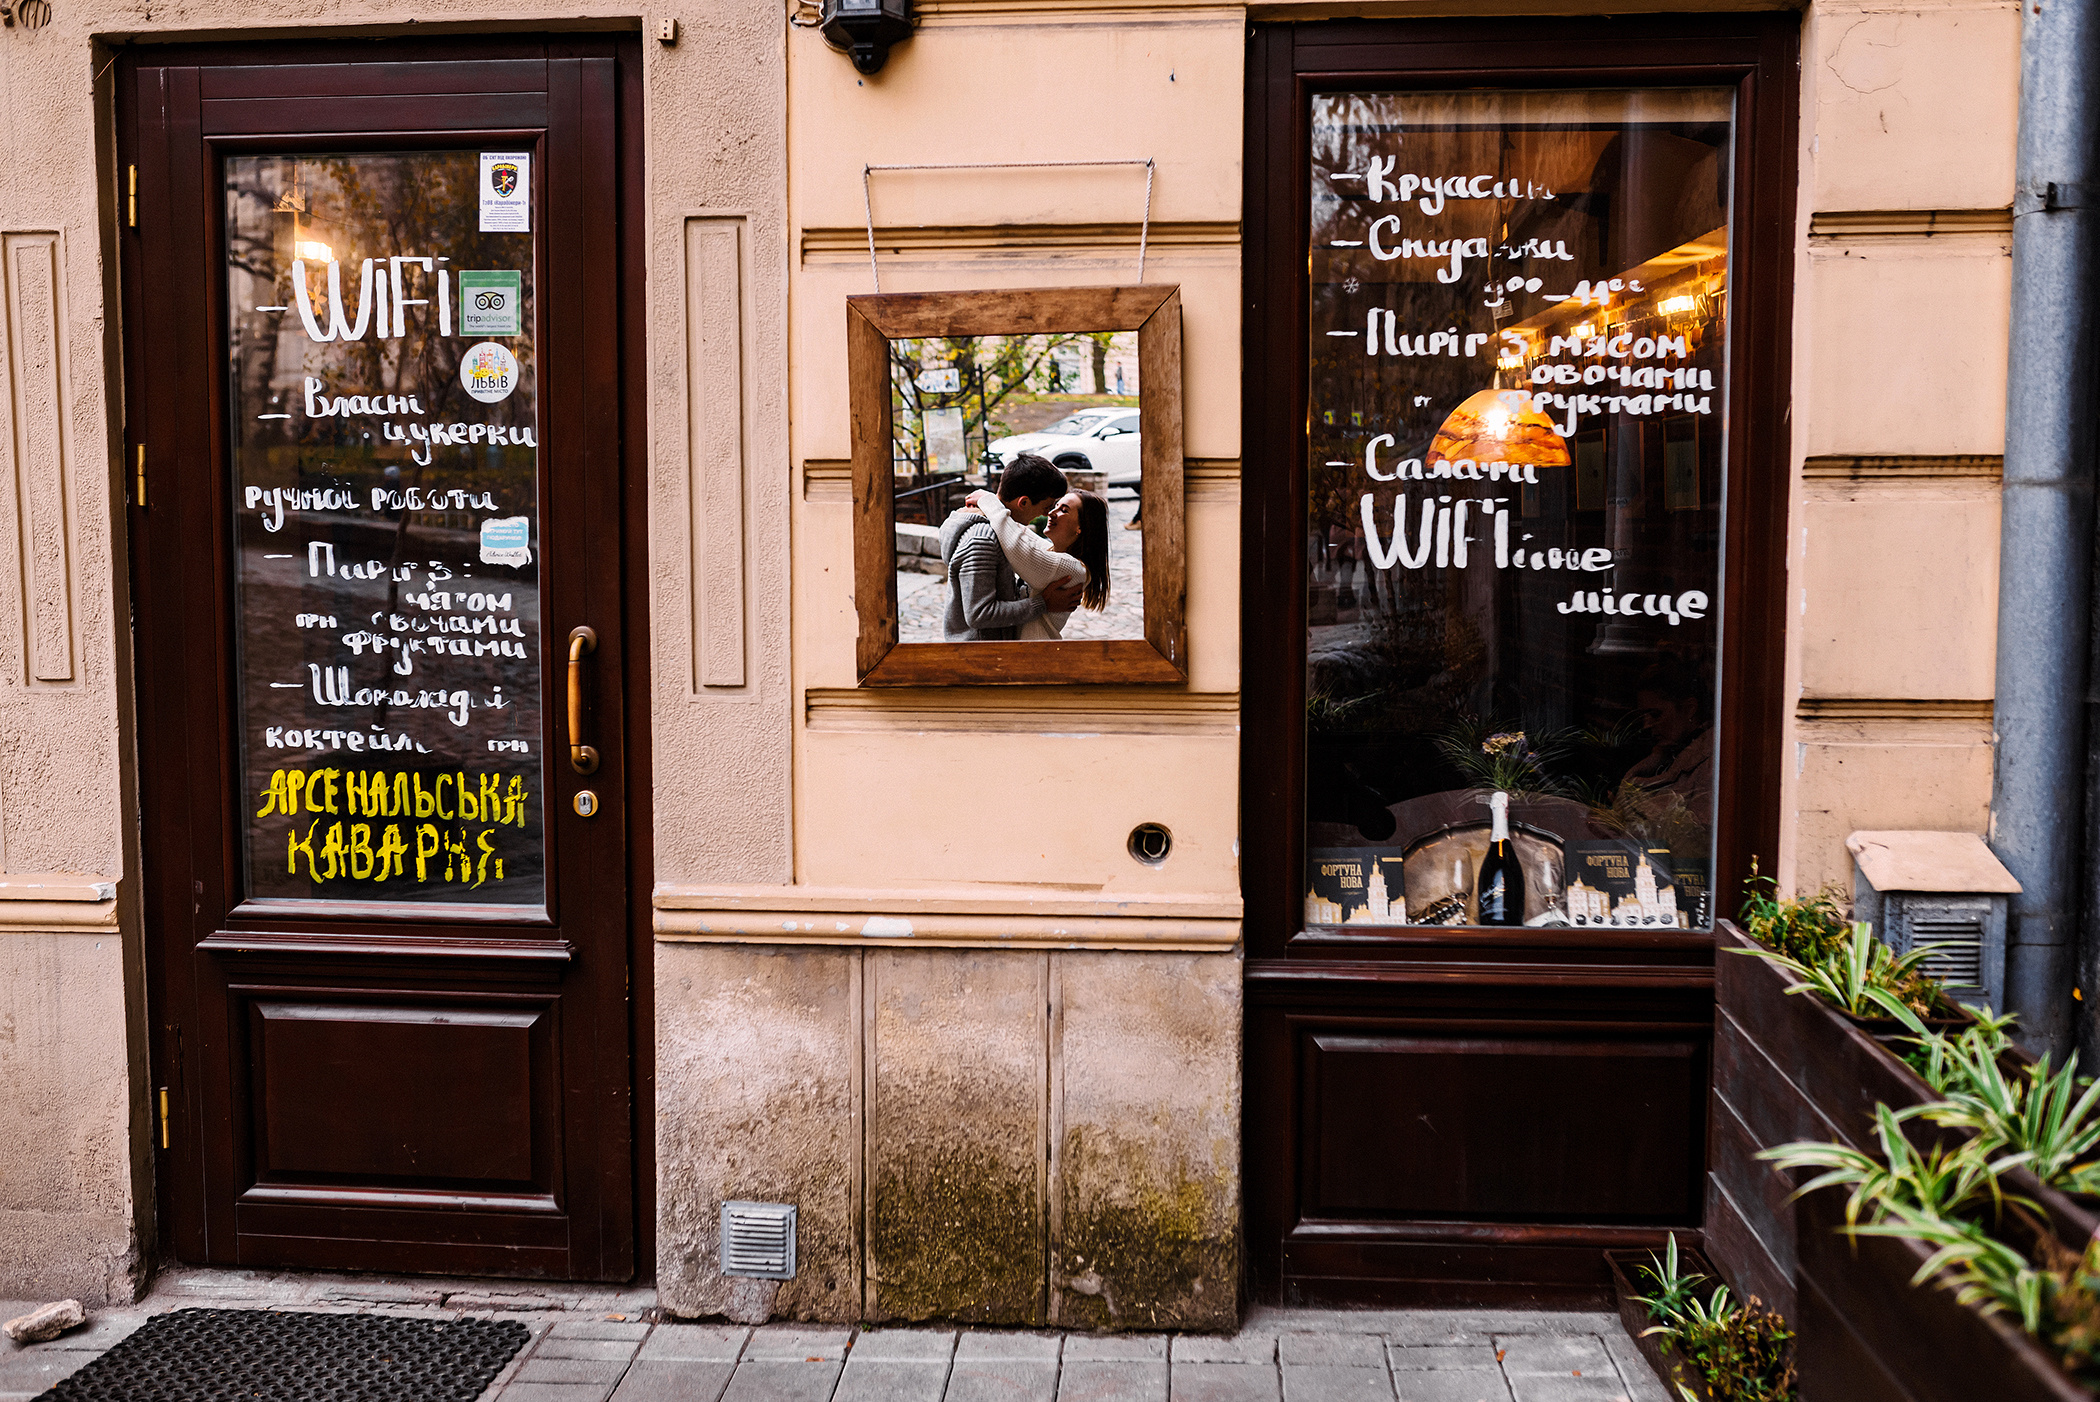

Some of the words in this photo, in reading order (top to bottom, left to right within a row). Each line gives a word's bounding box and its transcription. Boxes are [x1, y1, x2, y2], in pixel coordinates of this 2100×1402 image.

[292, 256, 451, 342] WiFi
[467, 313, 511, 323] tripadvisor
[1366, 307, 1488, 358] Пиріг
[471, 375, 509, 388] ЛЬВІВ
[1531, 364, 1716, 391] овочами
[383, 422, 537, 466] цукерки
[1366, 434, 1539, 484] Салати
[1557, 588, 1708, 626] місце
[256, 767, 529, 829] АРСЕНАЛЬСЬКА
[1321, 864, 1363, 876] ФОРТУНА
[1586, 855, 1629, 867] ФОРТУНА
[1606, 867, 1631, 878] НОВА
[1340, 876, 1364, 889] НОВА
